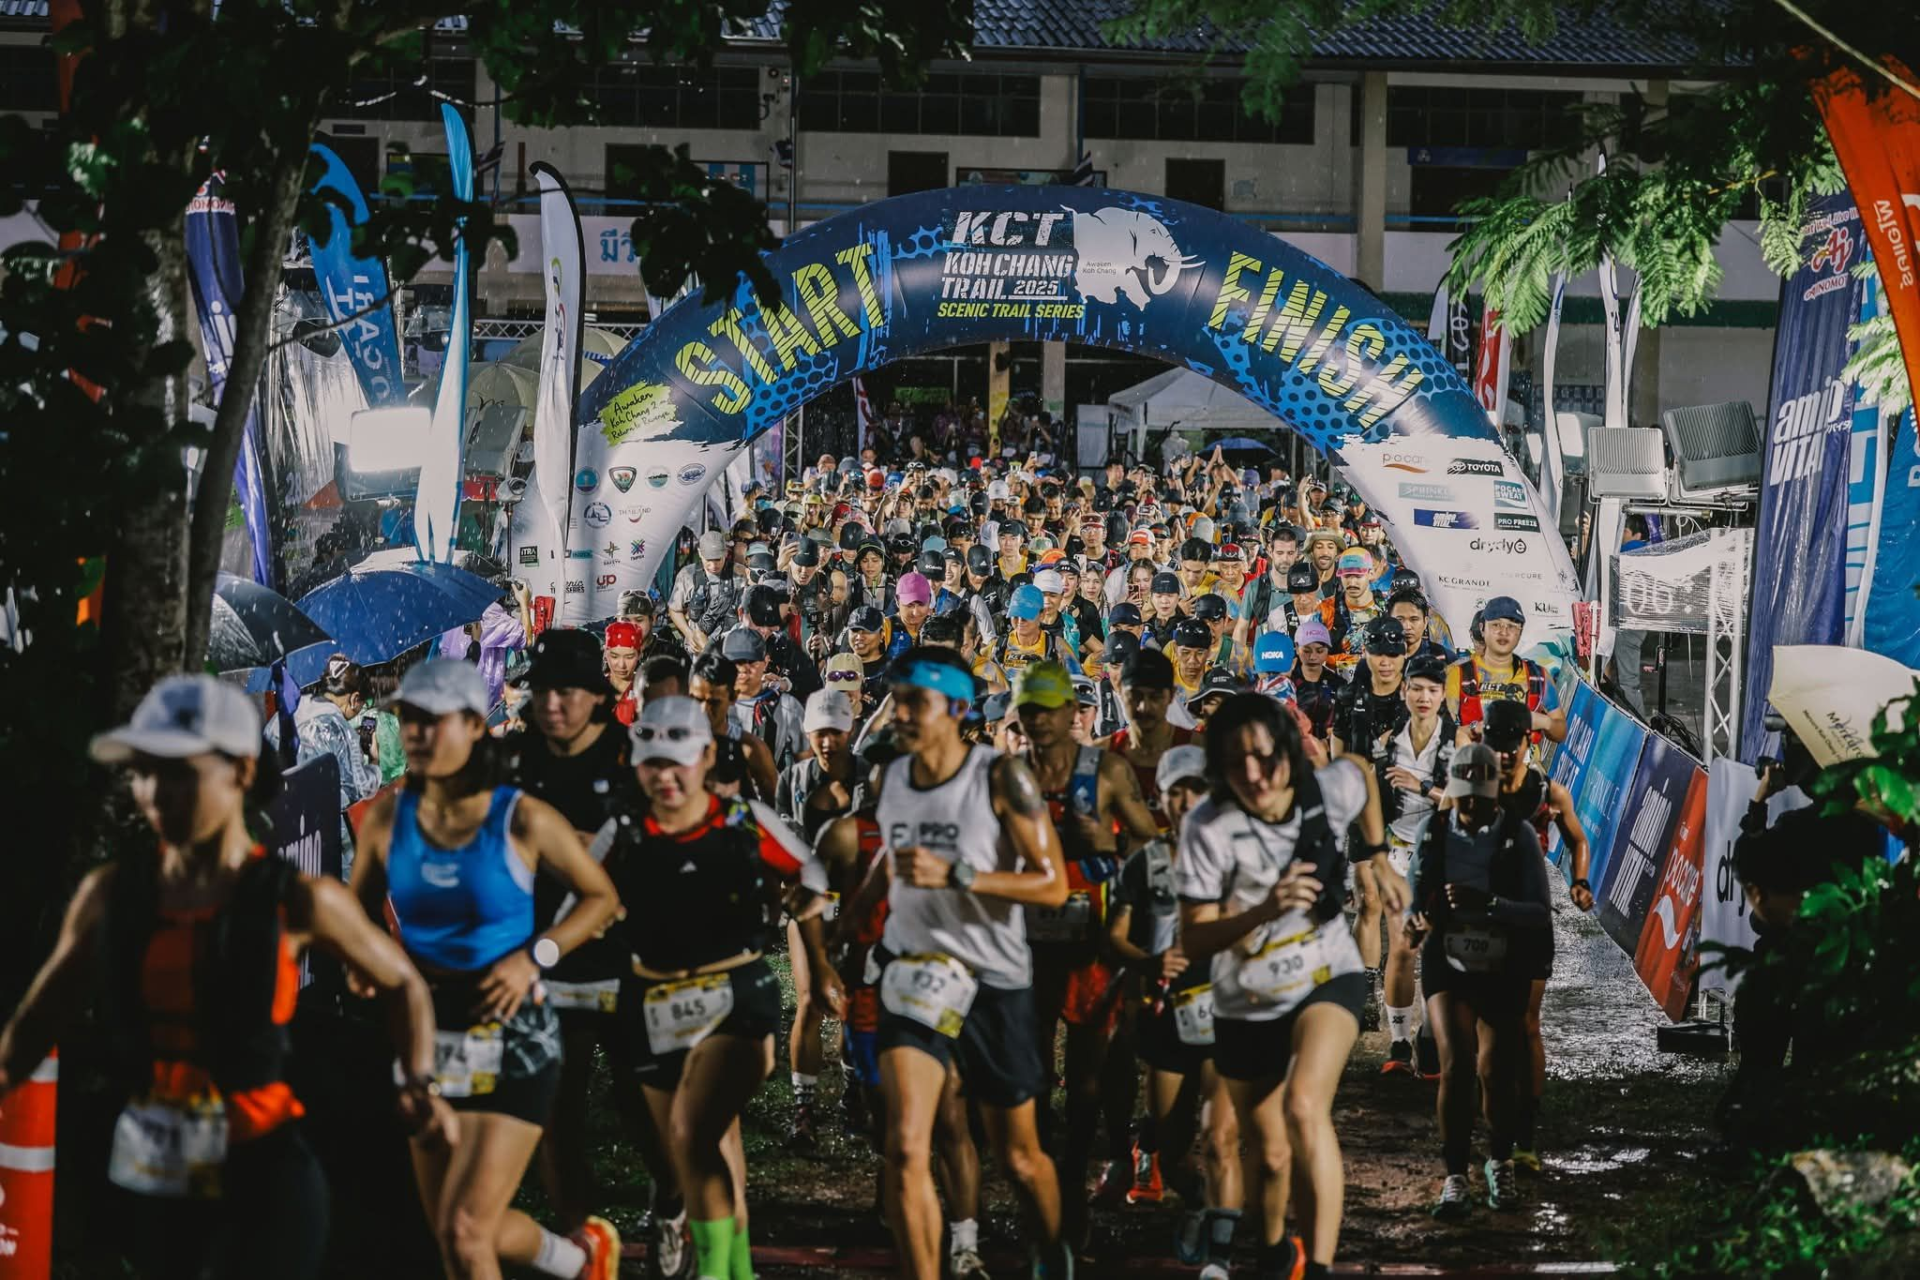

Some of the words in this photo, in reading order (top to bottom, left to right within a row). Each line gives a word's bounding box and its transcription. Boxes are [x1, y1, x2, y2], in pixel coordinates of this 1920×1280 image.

[953, 211, 1064, 246] KCT
[943, 252, 995, 276] KOH
[995, 253, 1073, 278] CHANG
[941, 277, 1008, 300] TRAIL
[1013, 280, 1059, 296] 2025
[938, 302, 990, 318] SCENIC
[992, 303, 1032, 319] TRAIL
[1035, 304, 1085, 320] SERIES
[676, 243, 884, 414] START
[1208, 251, 1424, 429] FINISH
[1466, 463, 1501, 473] TOYOTA
[1438, 575, 1450, 583] KC
[1262, 651, 1284, 660] HOKA
